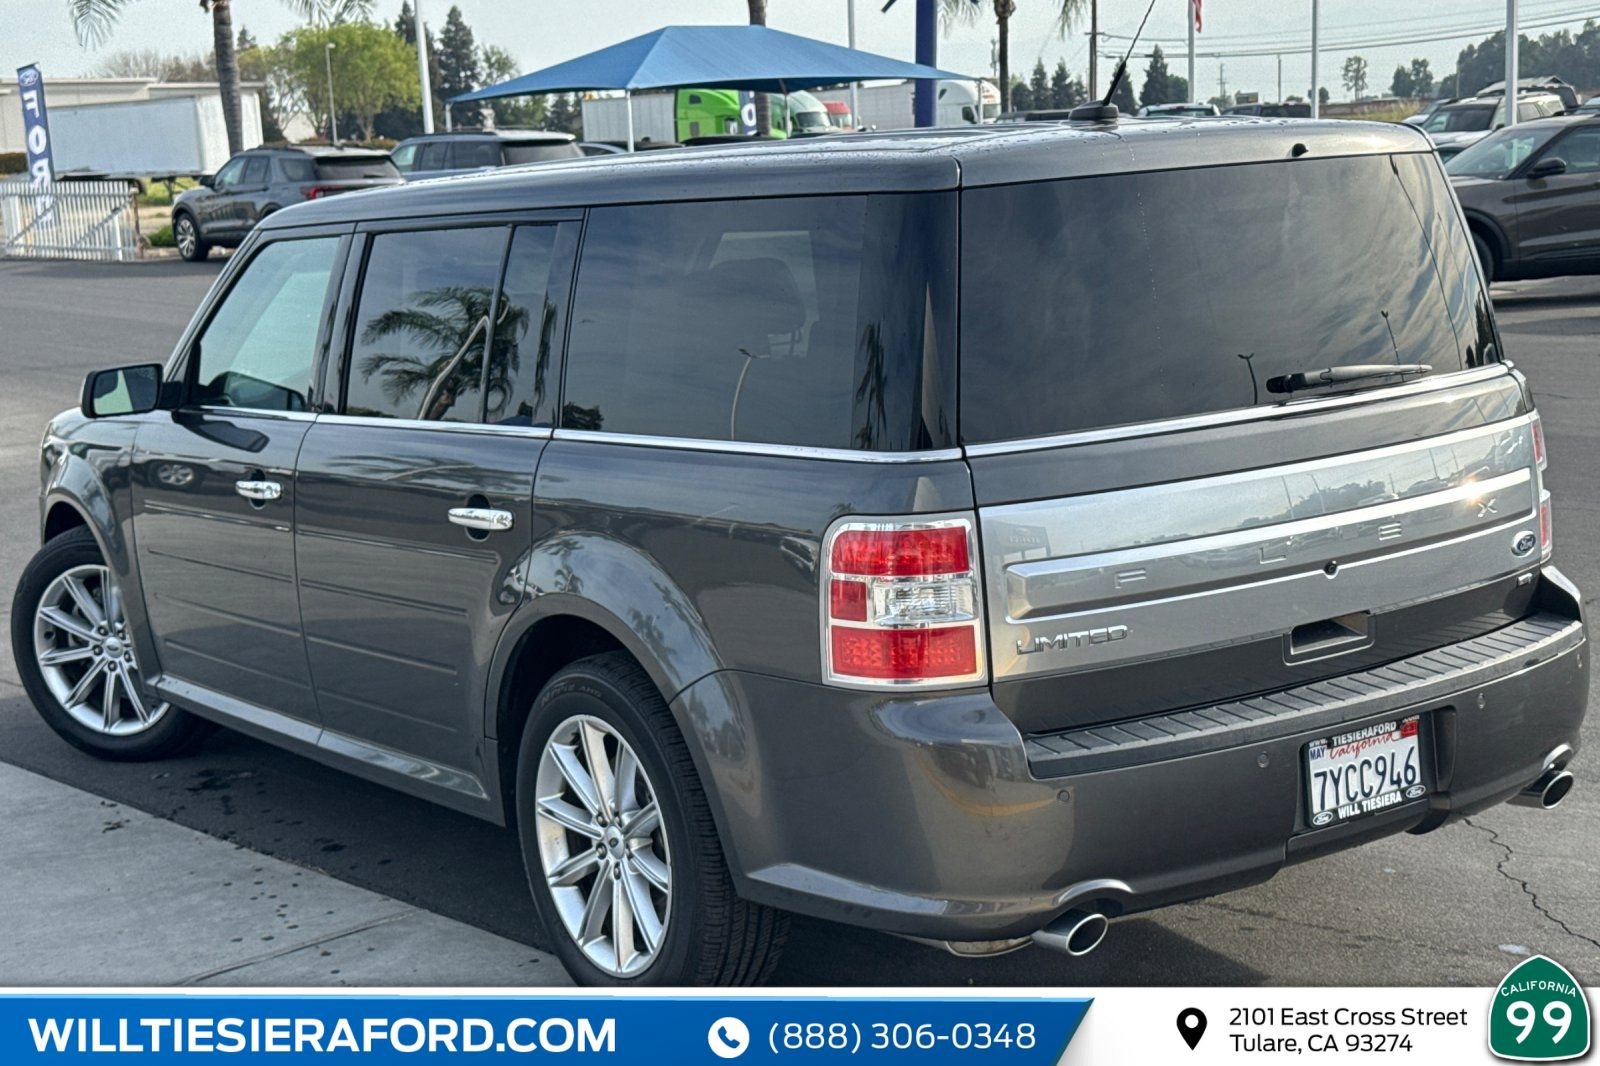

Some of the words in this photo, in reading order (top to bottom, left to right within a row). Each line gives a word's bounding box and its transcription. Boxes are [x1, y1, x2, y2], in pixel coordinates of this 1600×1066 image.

[1114, 498, 1498, 589] FLEX
[1016, 625, 1128, 655] LIMITED
[1329, 731, 1400, 759] California
[1332, 721, 1397, 746] TIESIERAFORD
[1310, 746, 1326, 760] MAY
[1314, 746, 1416, 811] 7YCC946
[1337, 802, 1361, 819] WILL
[1361, 791, 1402, 812] TIESIERA
